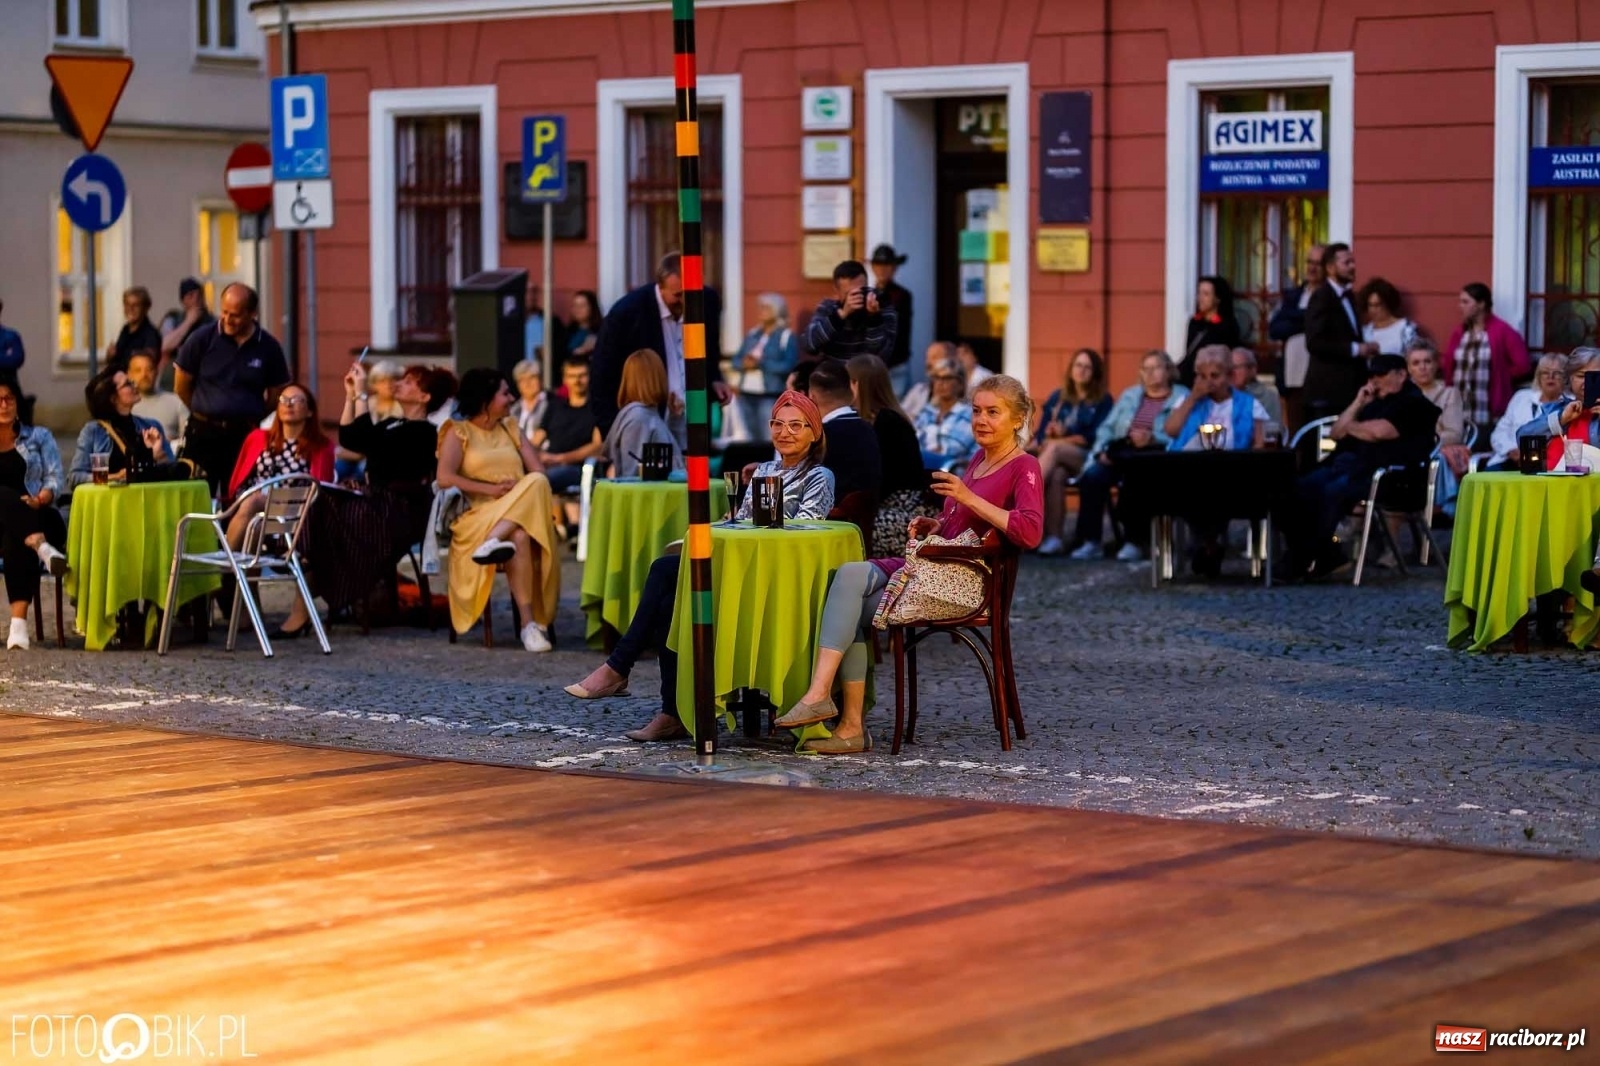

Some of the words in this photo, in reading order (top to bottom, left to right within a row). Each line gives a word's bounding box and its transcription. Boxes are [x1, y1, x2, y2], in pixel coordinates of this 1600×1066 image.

[283, 85, 315, 149] P
[533, 120, 557, 157] P
[1216, 119, 1315, 146] AGIMEX
[1221, 175, 1263, 186] AUSTRIA
[1553, 168, 1600, 179] AUSTRIA
